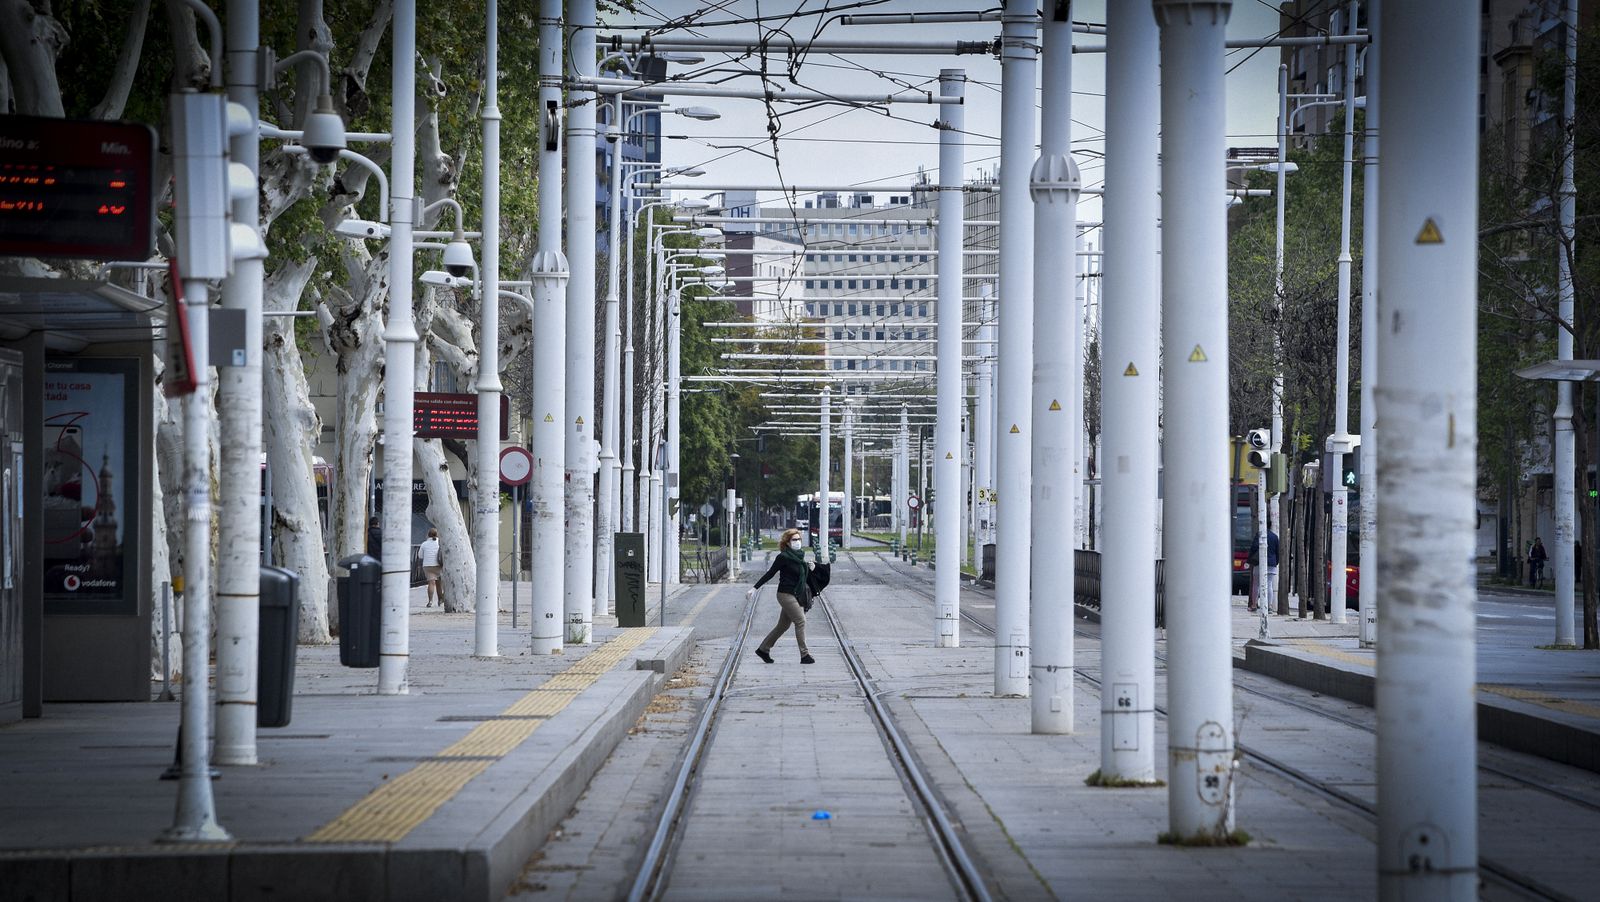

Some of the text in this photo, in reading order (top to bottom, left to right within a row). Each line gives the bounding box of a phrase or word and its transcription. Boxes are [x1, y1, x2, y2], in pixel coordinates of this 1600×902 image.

[101, 142, 132, 155] Min.
[57, 382, 66, 390] tu
[45, 392, 68, 401] tada
[979, 490, 985, 498] 3
[64, 564, 90, 573] Ready?
[1118, 697, 1131, 707] 66
